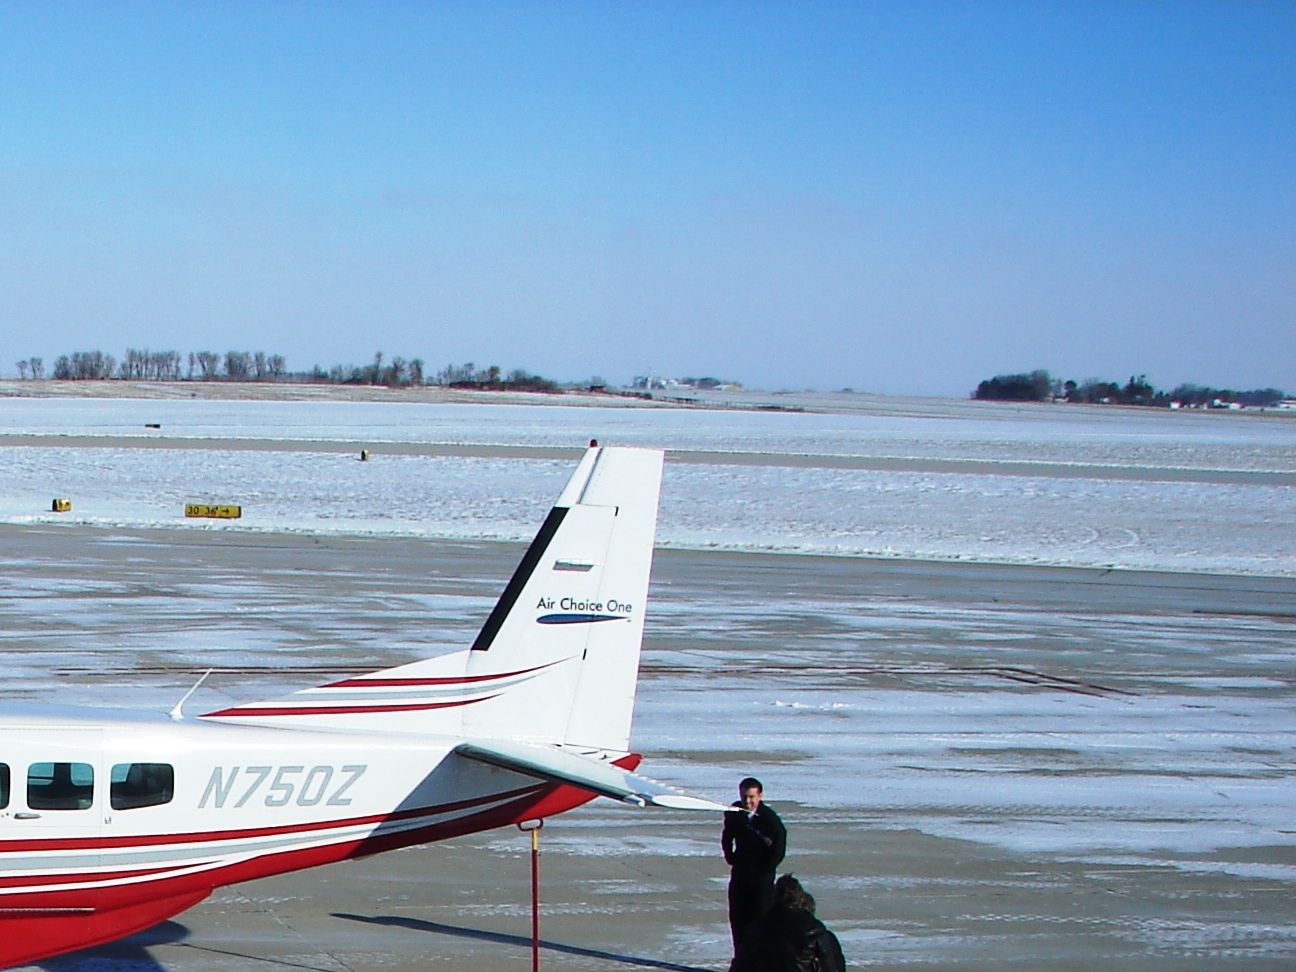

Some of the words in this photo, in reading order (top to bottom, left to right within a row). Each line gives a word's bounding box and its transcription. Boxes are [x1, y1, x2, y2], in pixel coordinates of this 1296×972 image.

[536, 597, 556, 610] Air
[560, 597, 603, 612] Choice
[607, 599, 632, 613] One
[197, 764, 368, 809] N750Z
